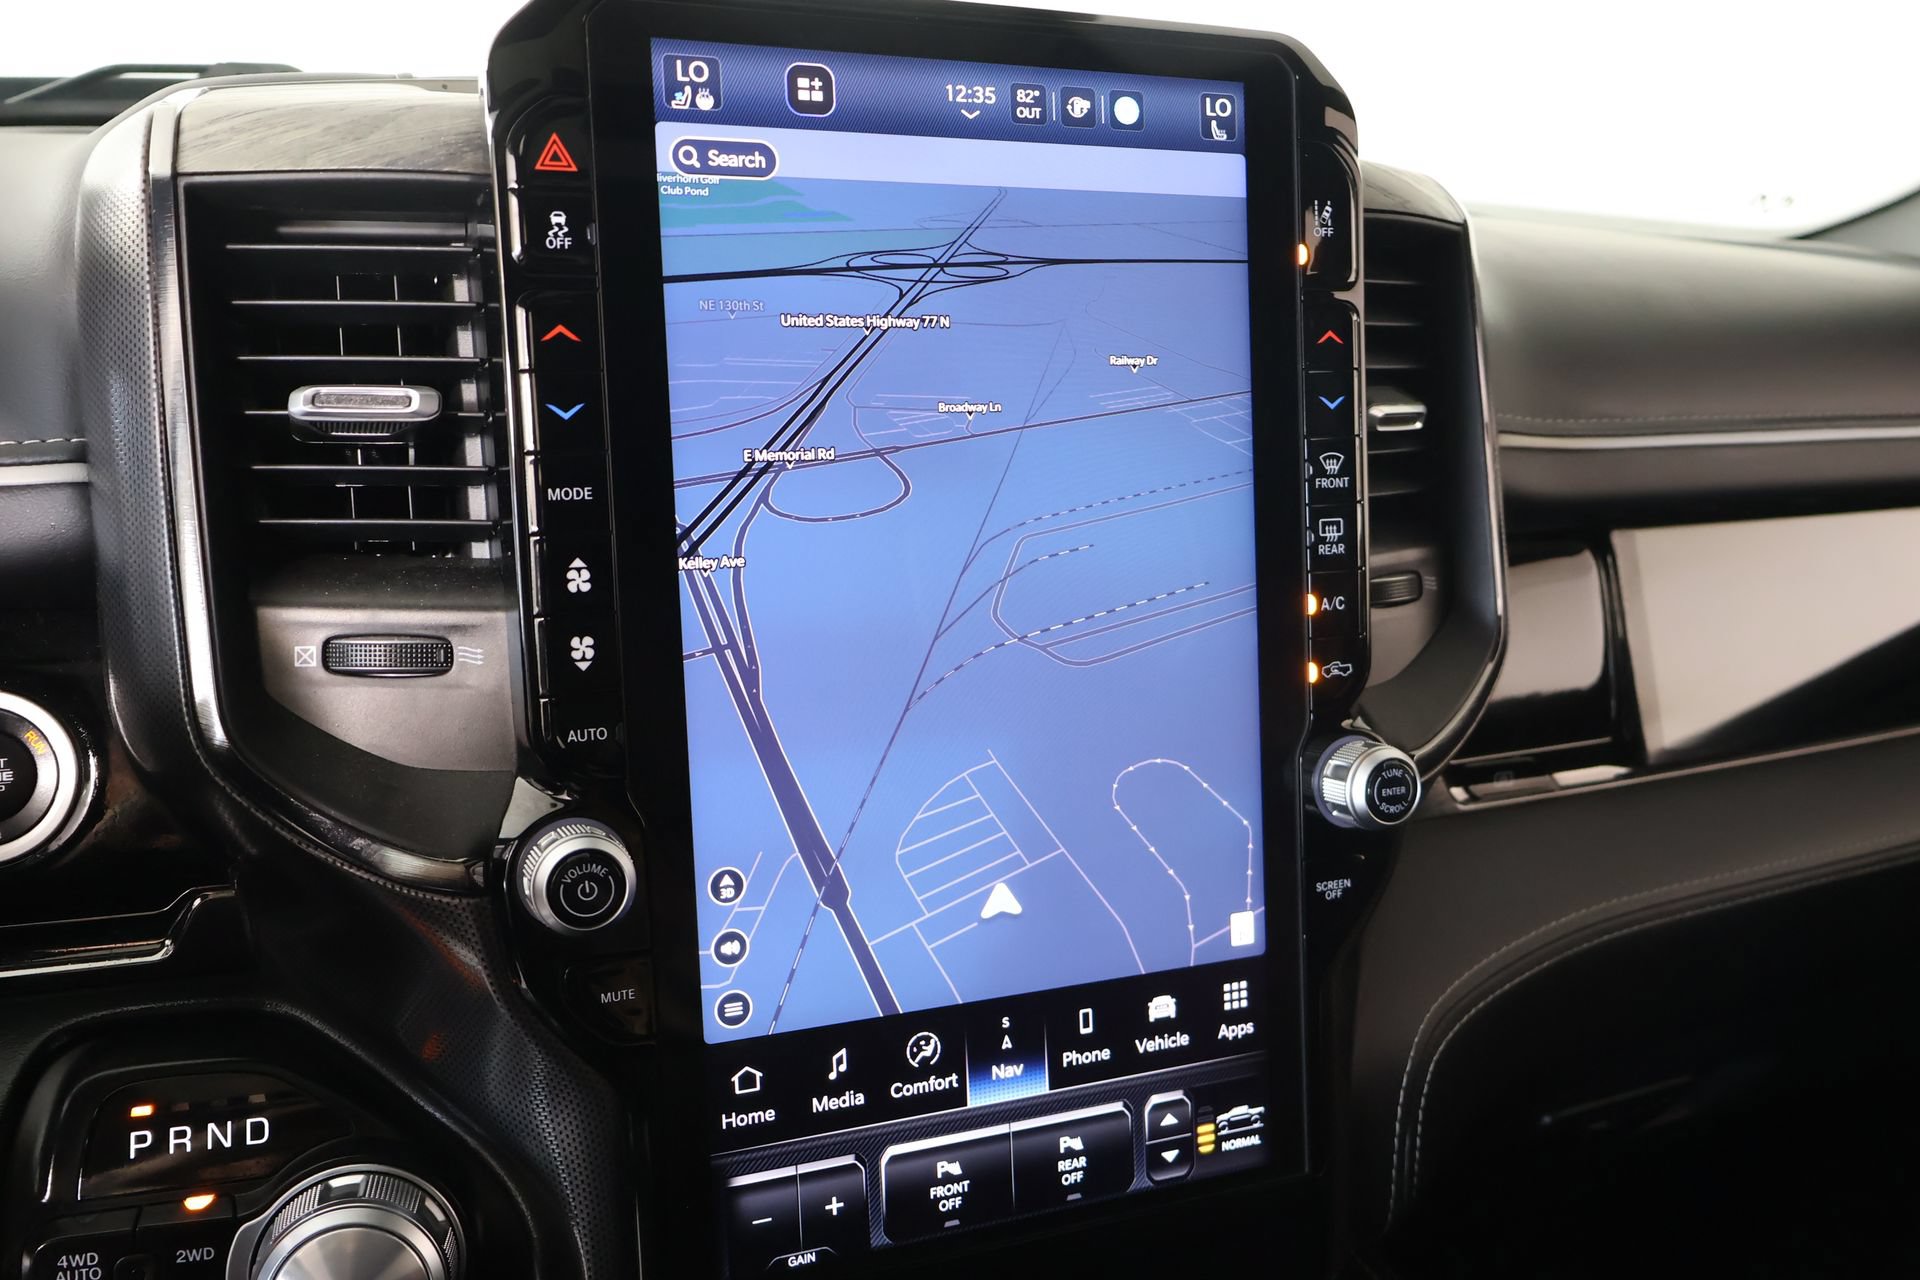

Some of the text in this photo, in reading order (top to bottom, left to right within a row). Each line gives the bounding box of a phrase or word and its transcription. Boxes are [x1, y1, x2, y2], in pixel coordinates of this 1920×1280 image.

[675, 60, 709, 83] LO
[945, 84, 996, 104] 12:35
[1016, 89, 1040, 103] 82°
[1016, 107, 1042, 119] OUT
[1205, 97, 1232, 117] LO
[707, 149, 766, 169] Search
[660, 185, 709, 196] Club Pond
[1313, 227, 1334, 238] OFF
[545, 237, 572, 249] OFF
[699, 300, 764, 311] NE 130th St
[780, 313, 950, 330] United States Highway 77 N
[1109, 355, 1158, 367] Railway Dr
[938, 402, 1002, 414] Broadway Ln
[743, 447, 835, 462] E Memorial Rd
[1315, 477, 1350, 489] FRONT
[547, 487, 593, 501] MODE
[1318, 544, 1345, 555] REAR
[678, 555, 746, 571] Kelley Ave
[1321, 596, 1345, 611] A/C
[24, 729, 47, 756] RUN
[567, 727, 608, 743] AUTO
[1382, 768, 1404, 779] TUNE
[1381, 786, 1406, 797] ENTER
[1379, 801, 1409, 814] SCROLL
[561, 863, 609, 884] VOLUME
[720, 887, 735, 899] 3D
[1316, 878, 1351, 892] SCREEN
[1325, 889, 1343, 900] OFF
[600, 988, 635, 1004] MUTE
[1217, 1020, 1254, 1041] Apps
[1134, 1031, 1190, 1054] Vehicle
[1062, 1047, 1111, 1068] Phone
[991, 1063, 1024, 1080] Nav
[890, 1072, 959, 1098] Comfort
[812, 1090, 865, 1113] Media
[721, 1108, 776, 1130] Home
[1221, 1134, 1261, 1152] NORMAL
[1057, 1156, 1087, 1172] REAR
[1061, 1170, 1084, 1185] OFF
[930, 1180, 970, 1199] FRONT
[938, 1196, 963, 1212] OFF
[57, 1252, 99, 1269] 4WD
[176, 1247, 215, 1263] 2WD
[787, 1252, 816, 1267] GAIN
[56, 1267, 102, 1280] AUTO
